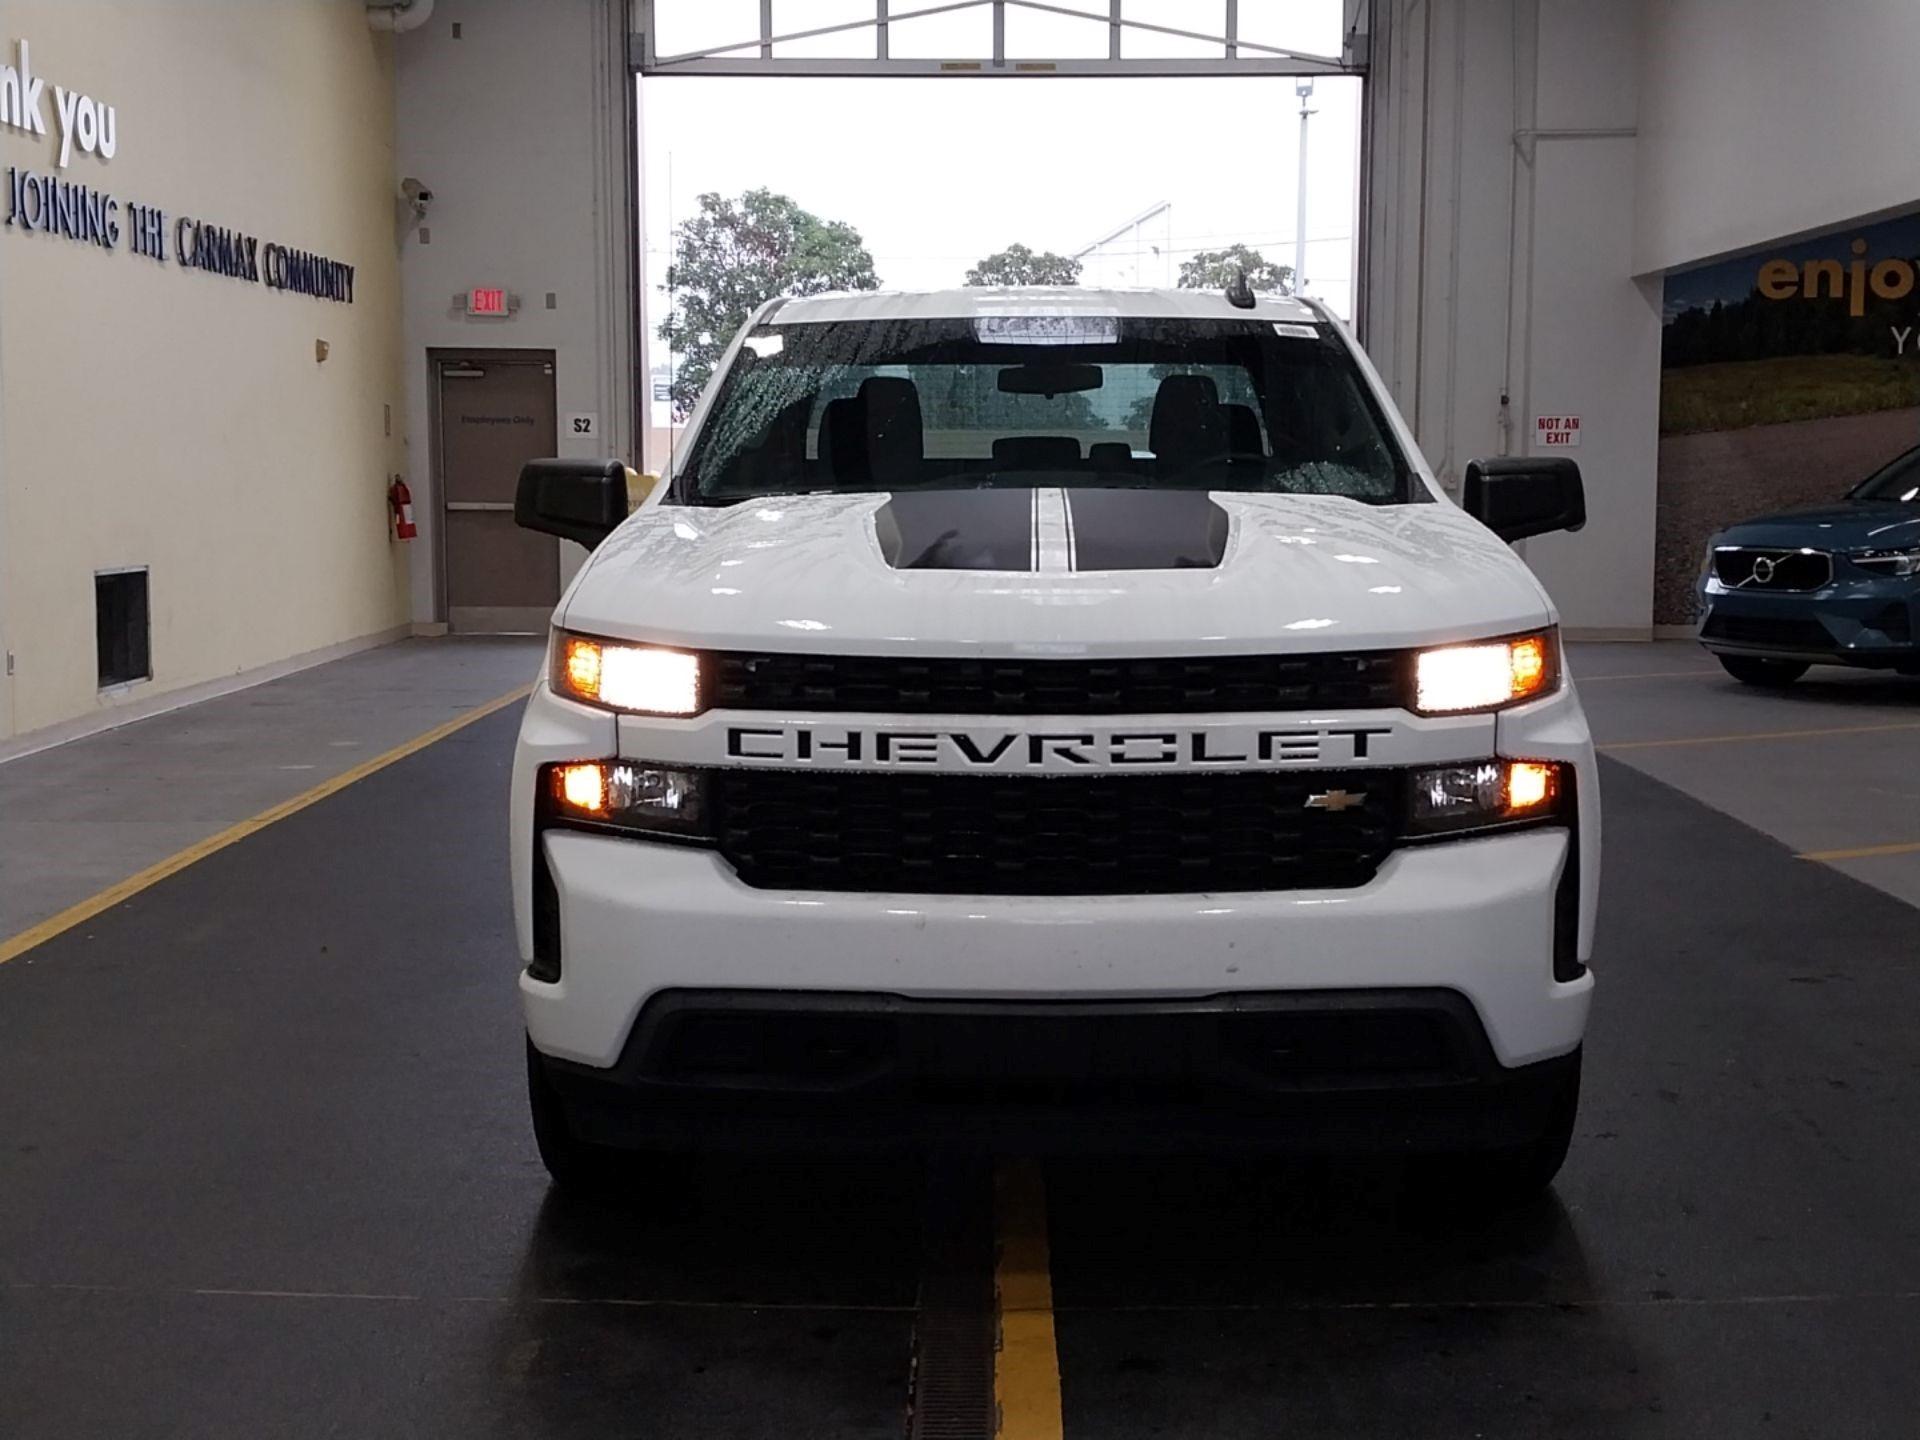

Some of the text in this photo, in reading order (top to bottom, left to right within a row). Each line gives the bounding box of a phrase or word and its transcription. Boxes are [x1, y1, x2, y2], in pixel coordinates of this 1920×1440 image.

[54, 85, 116, 168] you
[6, 167, 354, 303] JOINING THE CARMAX COMMUNITY
[1758, 238, 1920, 316] enjo
[472, 289, 504, 312] EXIT
[1891, 326, 1920, 354] Y
[461, 415, 534, 426] Employees Only
[573, 417, 591, 433] S2
[1538, 417, 1580, 430] NOT AN
[1546, 431, 1571, 444] EXIT
[727, 727, 1392, 765] CHEVROLET
